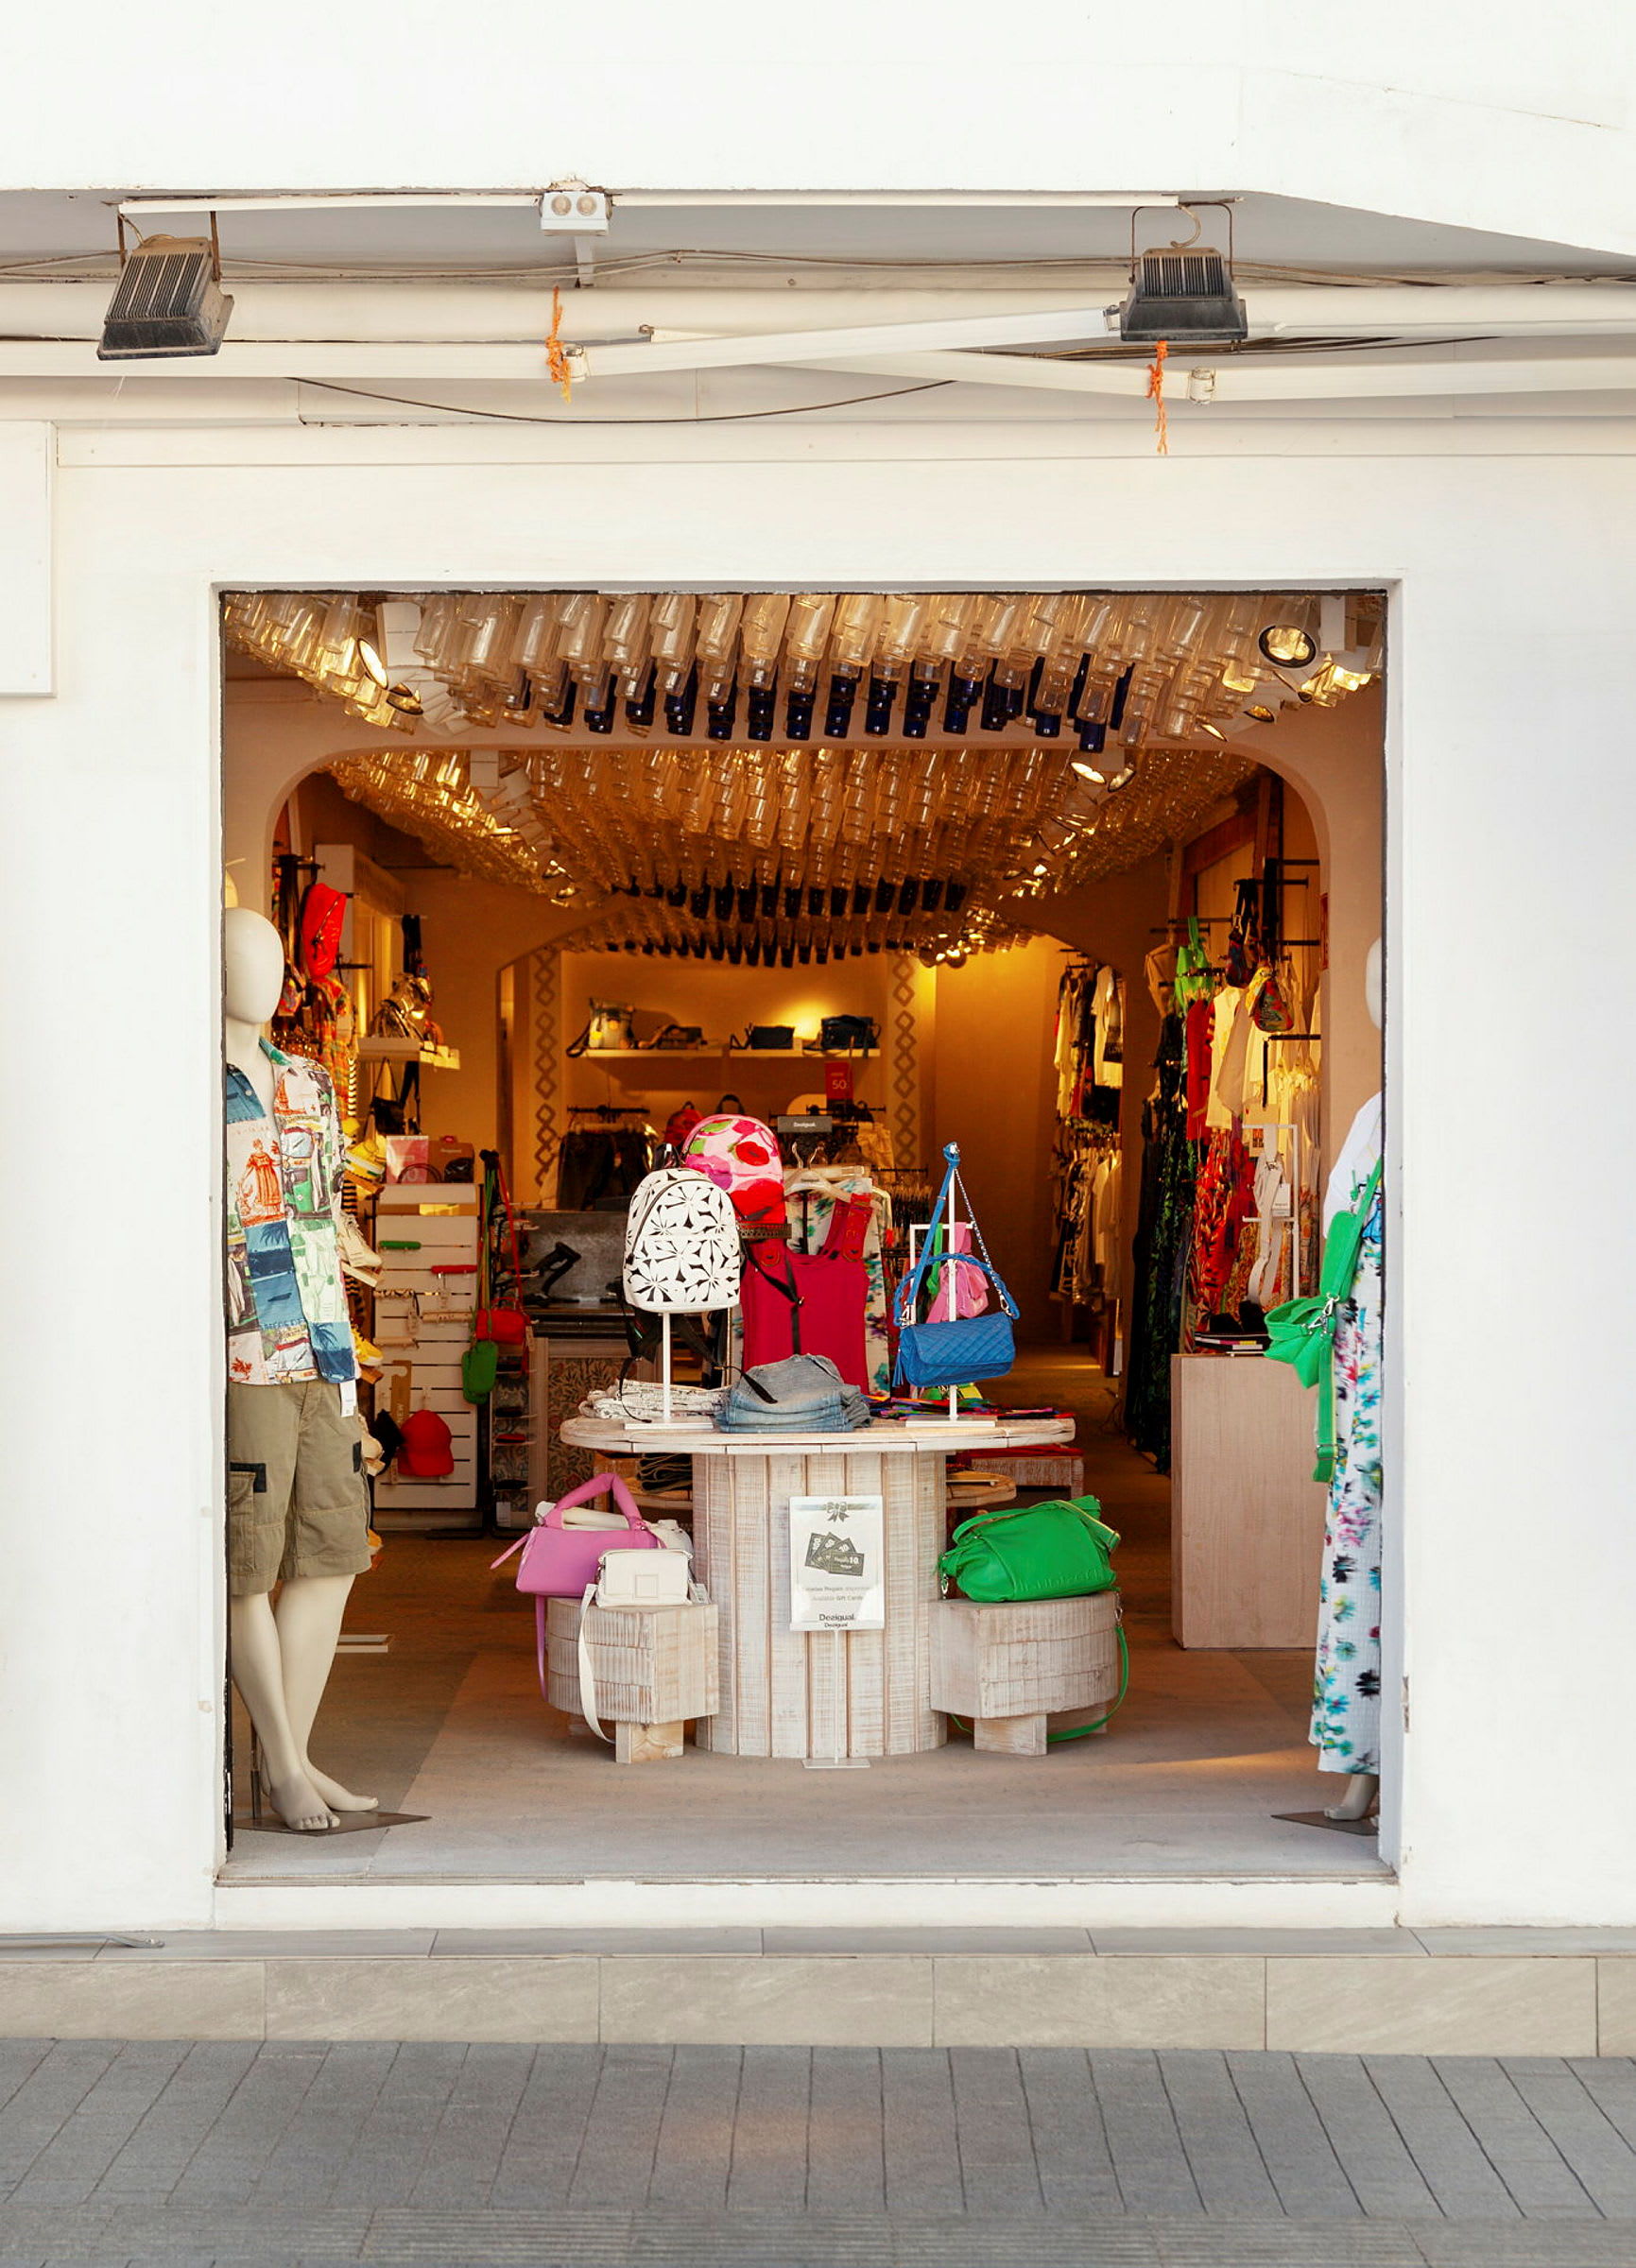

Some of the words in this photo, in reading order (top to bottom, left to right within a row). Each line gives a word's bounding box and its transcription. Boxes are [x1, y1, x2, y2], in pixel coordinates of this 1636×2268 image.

[832, 1079, 847, 1090] 50
[850, 1556, 859, 1565] 10
[818, 1613, 854, 1622] Desigual
